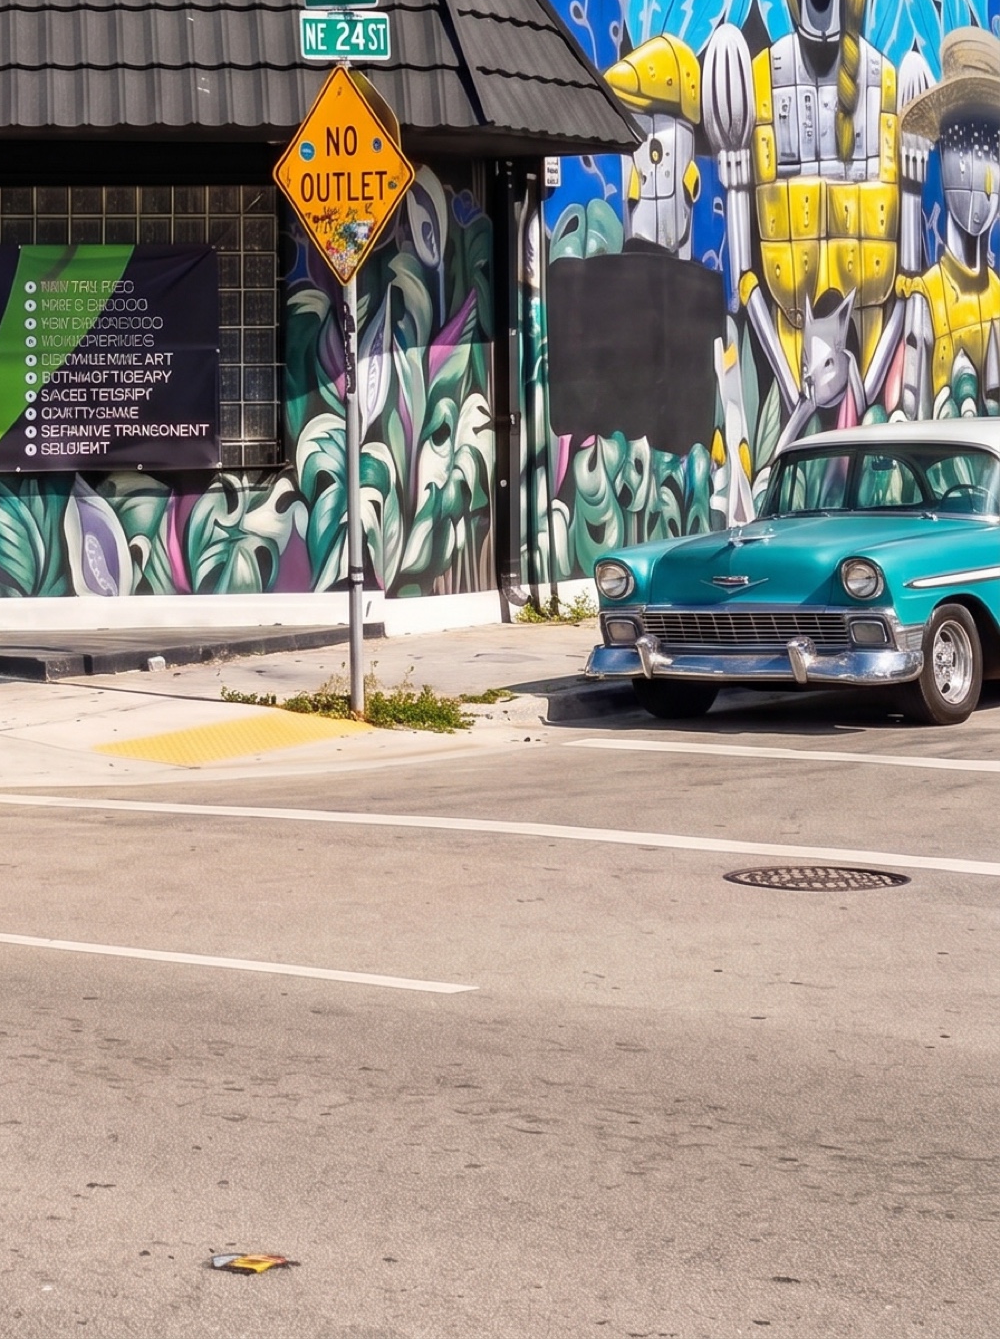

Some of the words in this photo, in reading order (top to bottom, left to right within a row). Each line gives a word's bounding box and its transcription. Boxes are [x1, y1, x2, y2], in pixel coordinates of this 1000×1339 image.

[305, 22, 327, 50] NE
[326, 125, 357, 156] NO
[300, 171, 387, 202] OUTLET
[144, 352, 174, 366] ART
